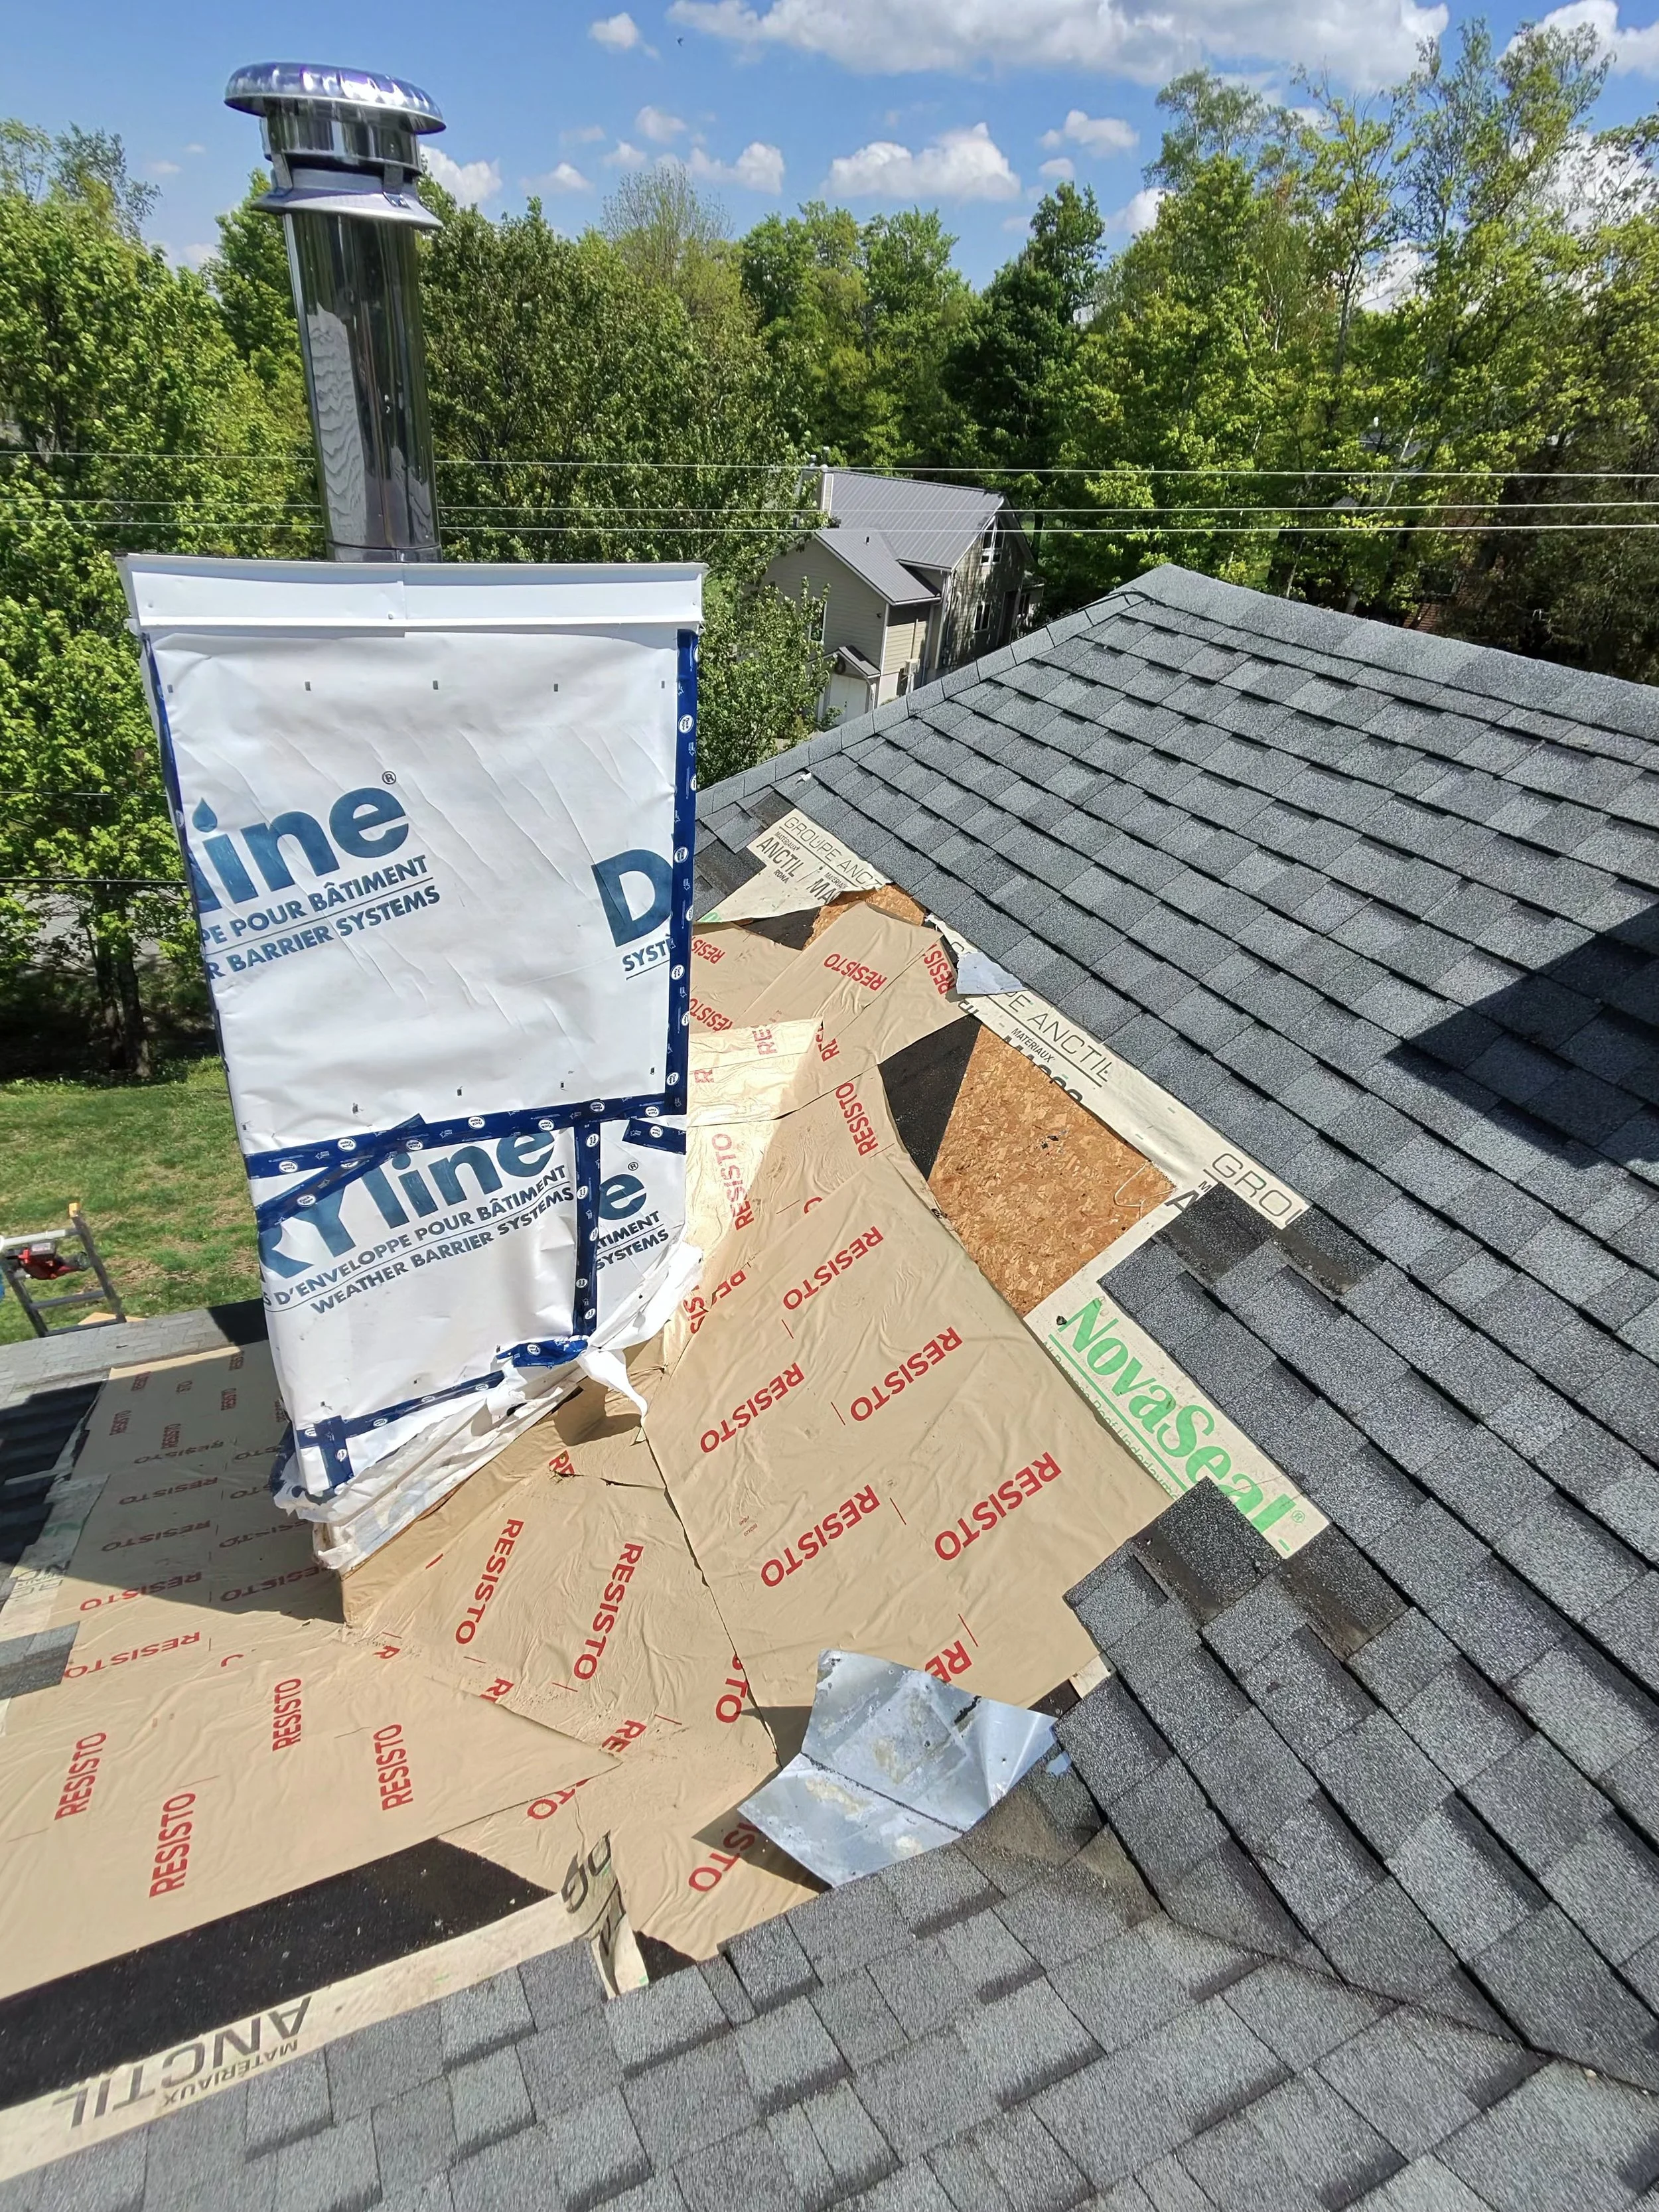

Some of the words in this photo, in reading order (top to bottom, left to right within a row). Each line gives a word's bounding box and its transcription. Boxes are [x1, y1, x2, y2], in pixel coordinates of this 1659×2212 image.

[757, 837, 804, 877] ANCTIL
[784, 817, 843, 863] GROUPE
[226, 925, 334, 973] BARRIER
[336, 885, 441, 936] SYSTEMS
[230, 900, 309, 938] POUR
[307, 854, 427, 913] BÂTIMENT
[824, 953, 888, 991] RESISTO
[1011, 1028, 1054, 1063] MATÉRIAUX
[1028, 1013, 1113, 1082] ANCTIL
[835, 1082, 879, 1156] RESISTO
[711, 1133, 755, 1231] RESISTO
[273, 1233, 412, 1305] D'ENVELOPPE
[414, 1212, 474, 1240] POUR
[476, 1165, 566, 1221] BÂTIMENT
[310, 1262, 409, 1314] WEATHER
[411, 1231, 494, 1269] BARRIER
[498, 1187, 574, 1236] SYSTEMS
[783, 1226, 883, 1310] RESISTO
[700, 1363, 805, 1453] RESISTO
[850, 1327, 963, 1422] RESISTO
[1058, 1297, 1297, 1534] NovaSeal
[119, 1476, 219, 1505] RESISTO
[935, 1452, 1062, 1561] RESISTO
[101, 1520, 211, 1552] RESISTO
[761, 1485, 881, 1587] RESISTO
[80, 1571, 202, 1611] RESISTO
[455, 1518, 525, 1645] RESISTO
[573, 1542, 644, 1680] RESISTO
[63, 1631, 201, 1679] RESISTO
[272, 1678, 303, 1752] RESISTO
[54, 1732, 108, 1820] RESISTO
[373, 1724, 414, 1811] RESISTO
[149, 1792, 197, 1899] RESISTO
[52, 1996, 313, 2129] ANCTIL
[163, 2039, 298, 2107] MATÉRIAUX
